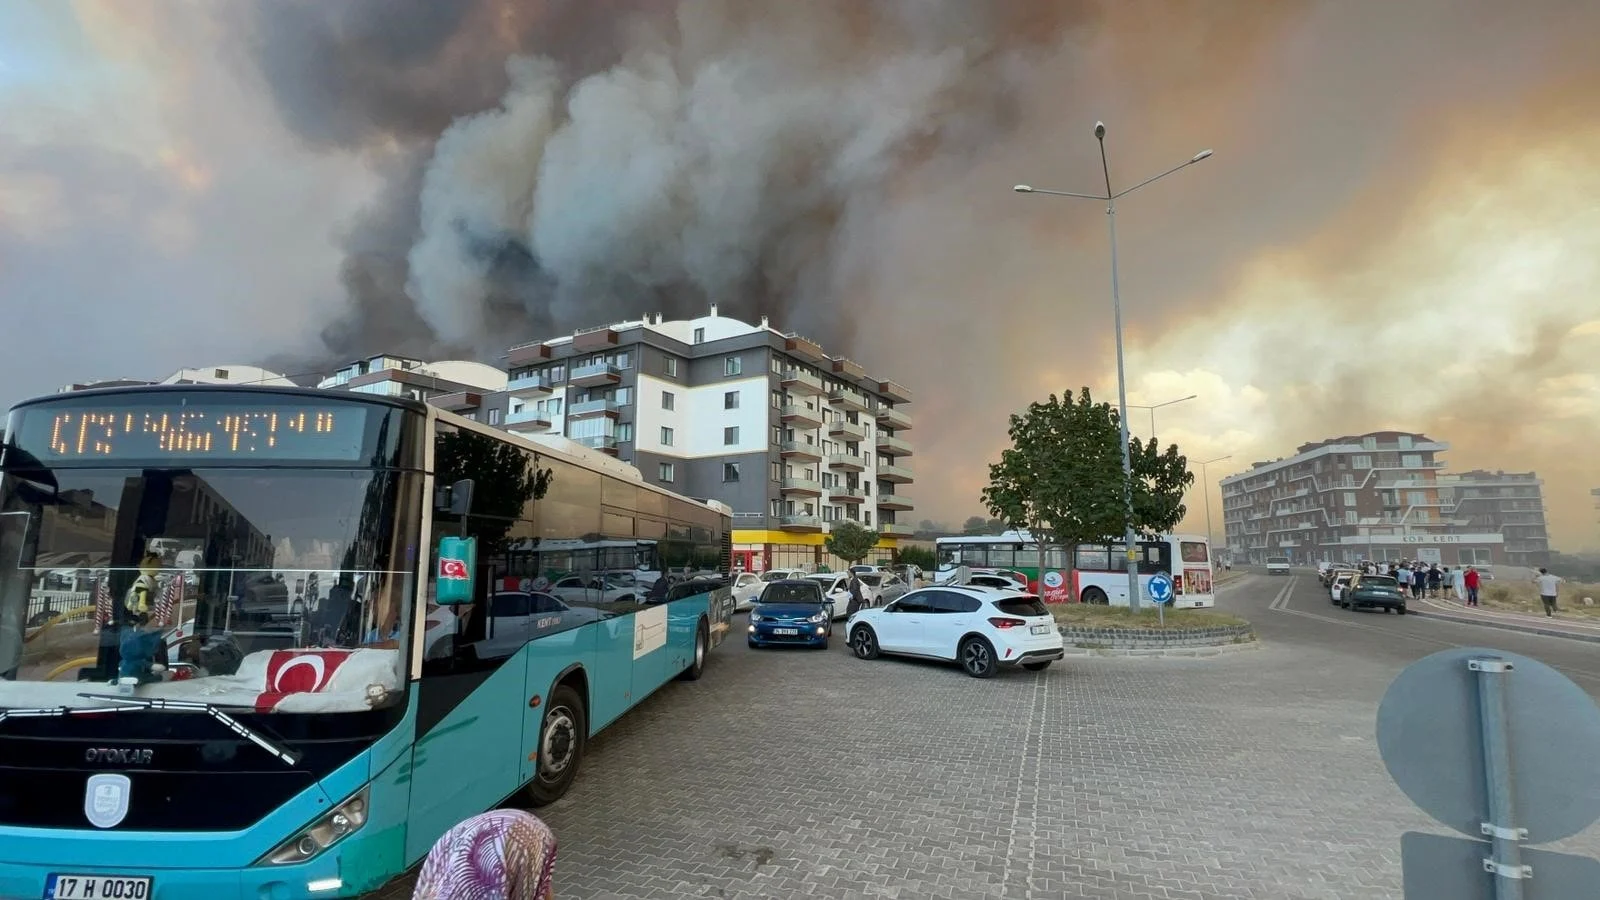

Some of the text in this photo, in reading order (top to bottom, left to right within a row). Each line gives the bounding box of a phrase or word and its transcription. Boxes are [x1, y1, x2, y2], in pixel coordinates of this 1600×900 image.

[85, 748, 153, 763] OTOKAR
[60, 878, 146, 899] 17 H 0030
